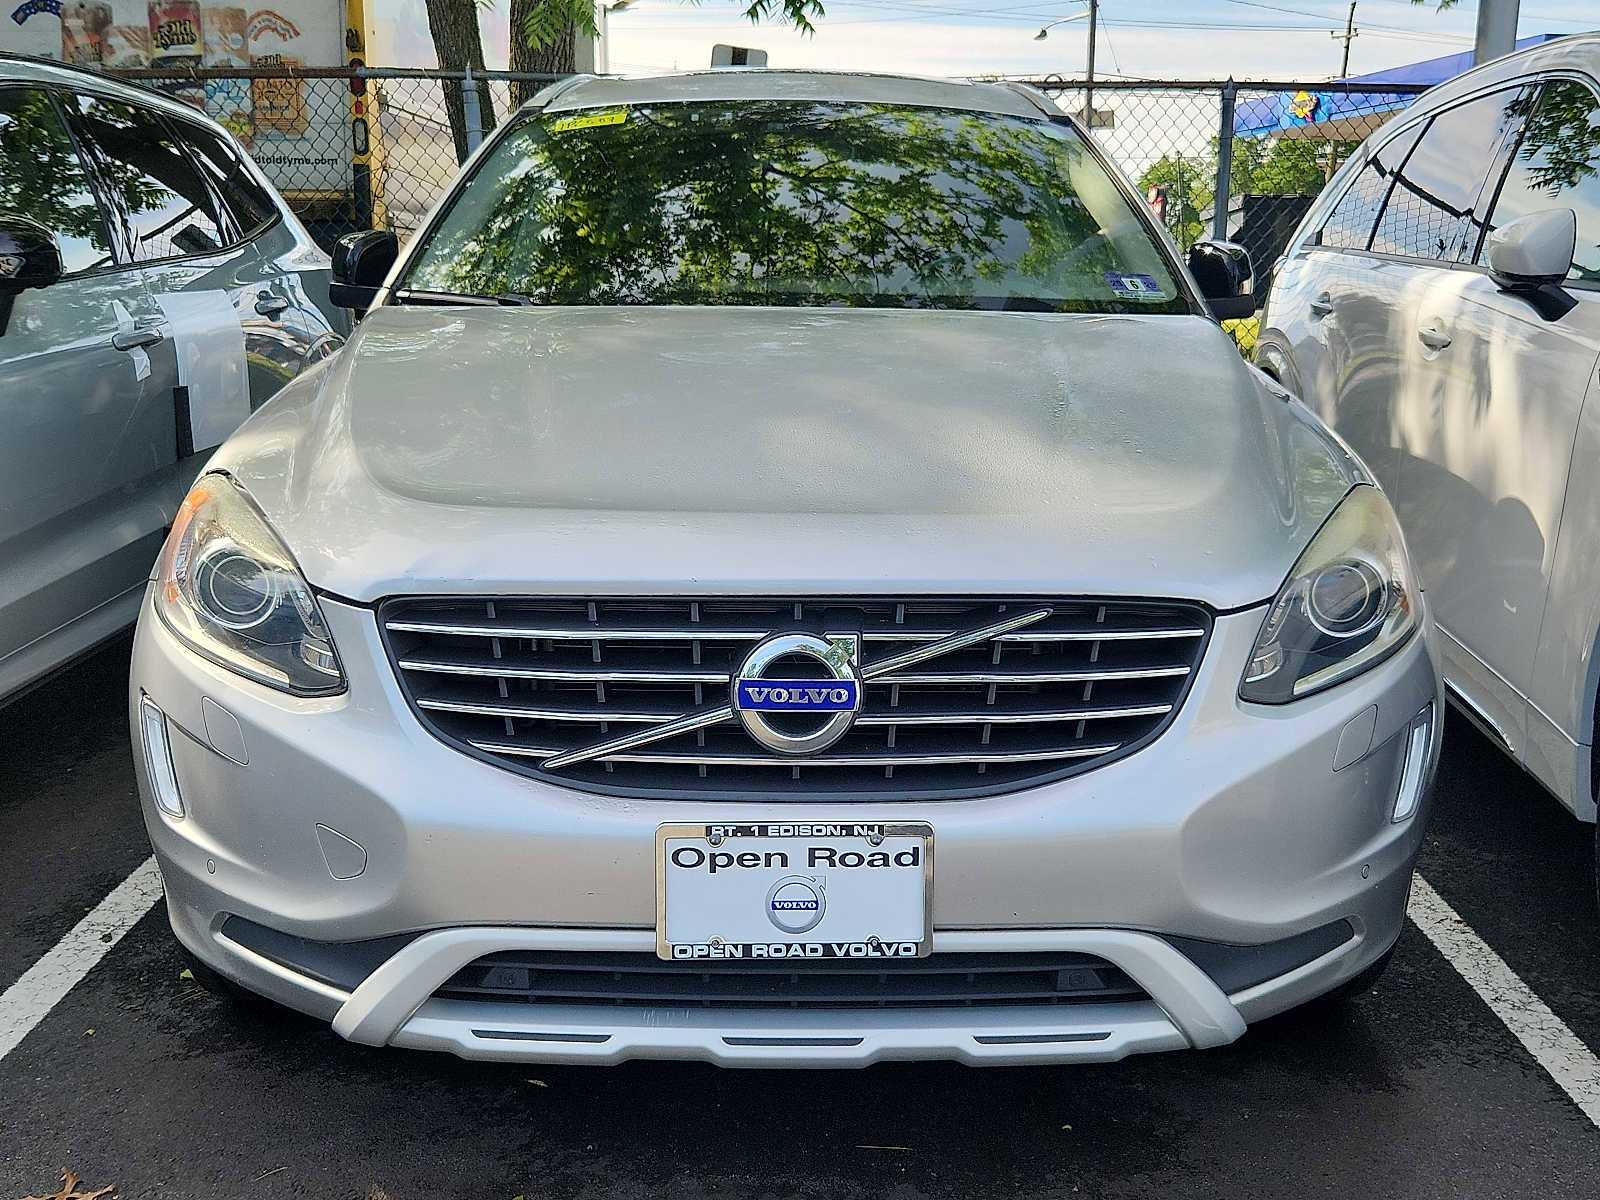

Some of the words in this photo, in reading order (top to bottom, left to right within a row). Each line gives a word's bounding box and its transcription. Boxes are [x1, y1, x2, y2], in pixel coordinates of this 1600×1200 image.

[1129, 279, 1139, 290] 6
[744, 687, 849, 704] VOLVO
[750, 825, 760, 837] 1
[767, 825, 847, 837] EDISON,
[853, 825, 879, 837] NJ
[671, 847, 789, 874] Open
[807, 846, 920, 868] Road
[773, 901, 817, 909] VOLVO
[674, 944, 743, 958] OPEN
[751, 943, 824, 957] ROAD
[831, 943, 917, 957] VOLVO
